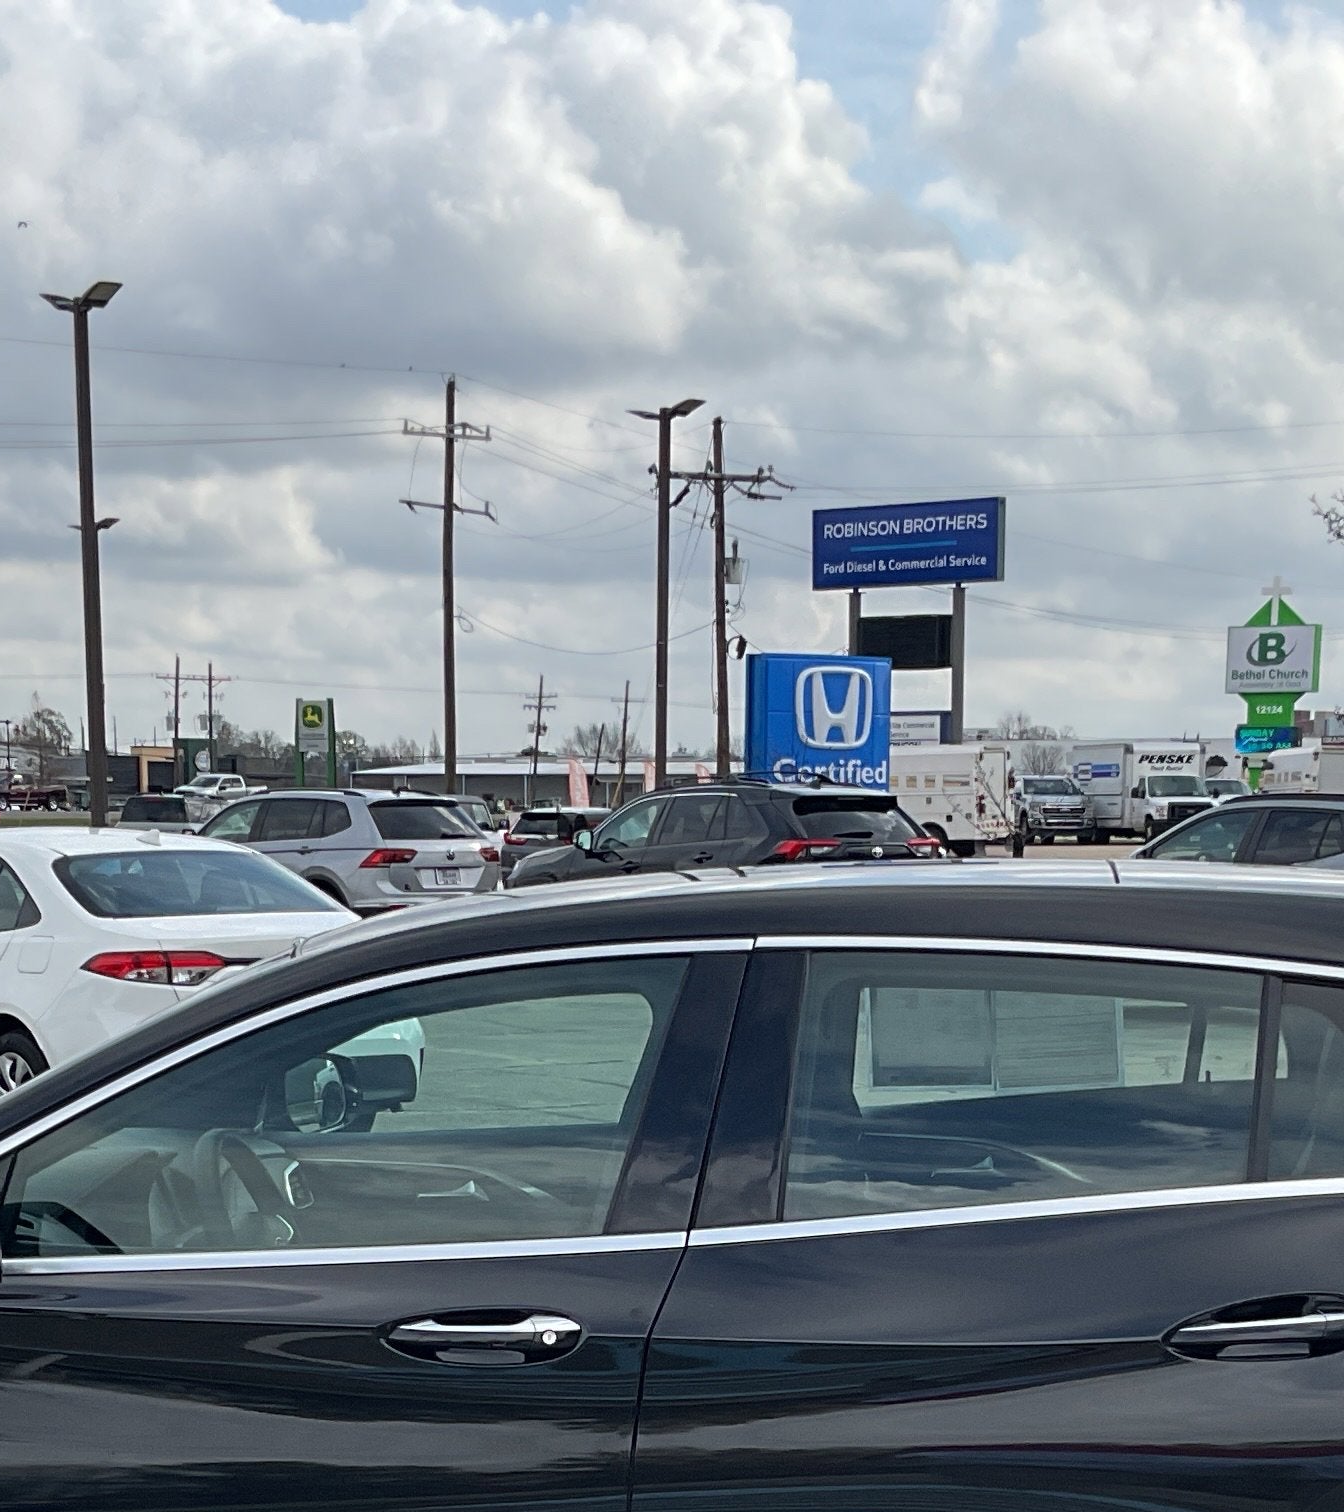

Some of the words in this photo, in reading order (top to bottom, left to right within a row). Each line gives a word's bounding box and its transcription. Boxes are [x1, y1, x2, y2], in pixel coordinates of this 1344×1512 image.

[824, 520, 900, 540] ROBINSON
[903, 513, 988, 534] BROTHERS
[824, 562, 845, 574] Ford
[847, 559, 876, 573] Diesel
[878, 560, 887, 571] &
[888, 556, 947, 571] Commercial
[949, 554, 987, 567] Service
[1231, 669, 1265, 680] Bethel
[1269, 668, 1308, 680] Church
[1256, 705, 1283, 715] 12124
[1138, 754, 1195, 764] PENSKE
[772, 758, 887, 784] Certified
